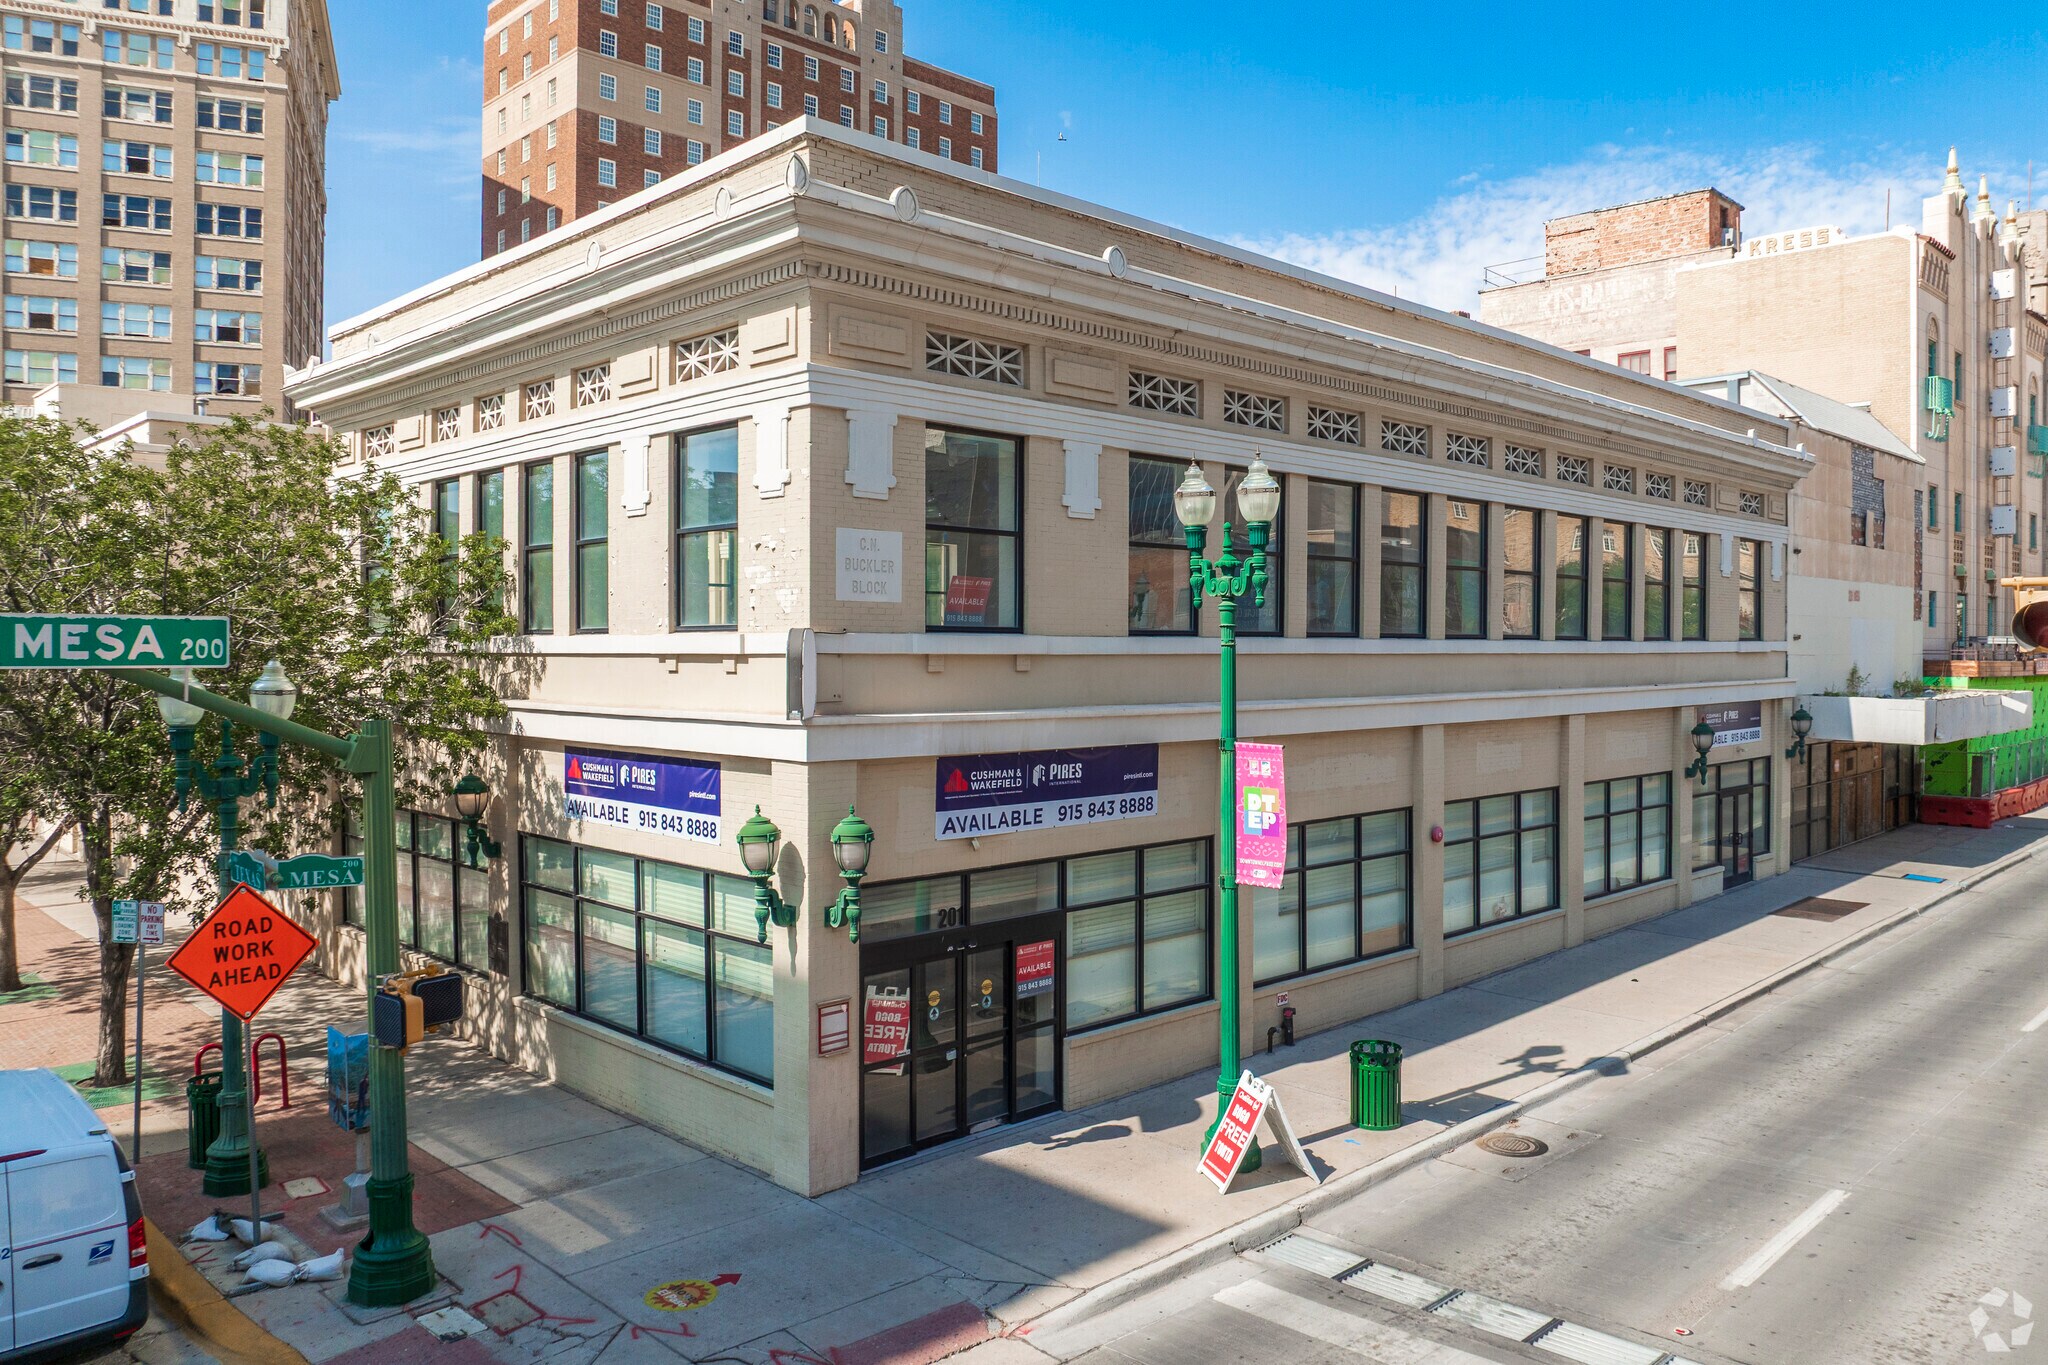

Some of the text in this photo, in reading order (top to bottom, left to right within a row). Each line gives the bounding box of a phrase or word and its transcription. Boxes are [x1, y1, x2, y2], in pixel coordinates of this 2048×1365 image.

[1749, 228, 1829, 257] KRESS
[845, 557, 894, 574] BUCKLER
[852, 580, 887, 594] BLOCK
[949, 597, 984, 606] AVAILABLE
[946, 614, 956, 622] 915
[969, 615, 982, 623] 8888
[14, 624, 223, 661] MESA 200
[1731, 732, 1739, 742] 915
[1740, 731, 1749, 741] 843
[1749, 730, 1760, 740] 8888
[582, 762, 614, 773] CUSHMAN &
[631, 766, 656, 785] PIRES
[970, 768, 1022, 781] CUSHMAN &
[1049, 762, 1083, 780] PIRES
[1123, 771, 1154, 781] piresintl.com
[582, 771, 615, 783] WAKEFIELD
[970, 778, 1022, 790] WAKEFIELD
[1247, 793, 1276, 812] DT
[567, 799, 717, 839] AVAILABLE 915 843 8888
[941, 796, 1154, 835] AVAILABLE 915 843 8888
[1247, 811, 1277, 830] EP
[342, 860, 359, 868] 200
[234, 865, 261, 889] TEXAS
[290, 869, 357, 886] MESA
[147, 905, 157, 914] NO
[938, 906, 963, 928] 201
[141, 915, 163, 924] PARKING
[213, 917, 273, 939] ROAD
[213, 940, 274, 963] WORK
[208, 963, 282, 989] AHEAD
[1018, 961, 1052, 975] AVAILABLE
[1018, 978, 1052, 992] 915 843 8888
[1277, 993, 1288, 1004] FDC
[1232, 1103, 1251, 1125] BOGO
[1219, 1117, 1249, 1149] FREE
[1214, 1139, 1235, 1164] TORTA
